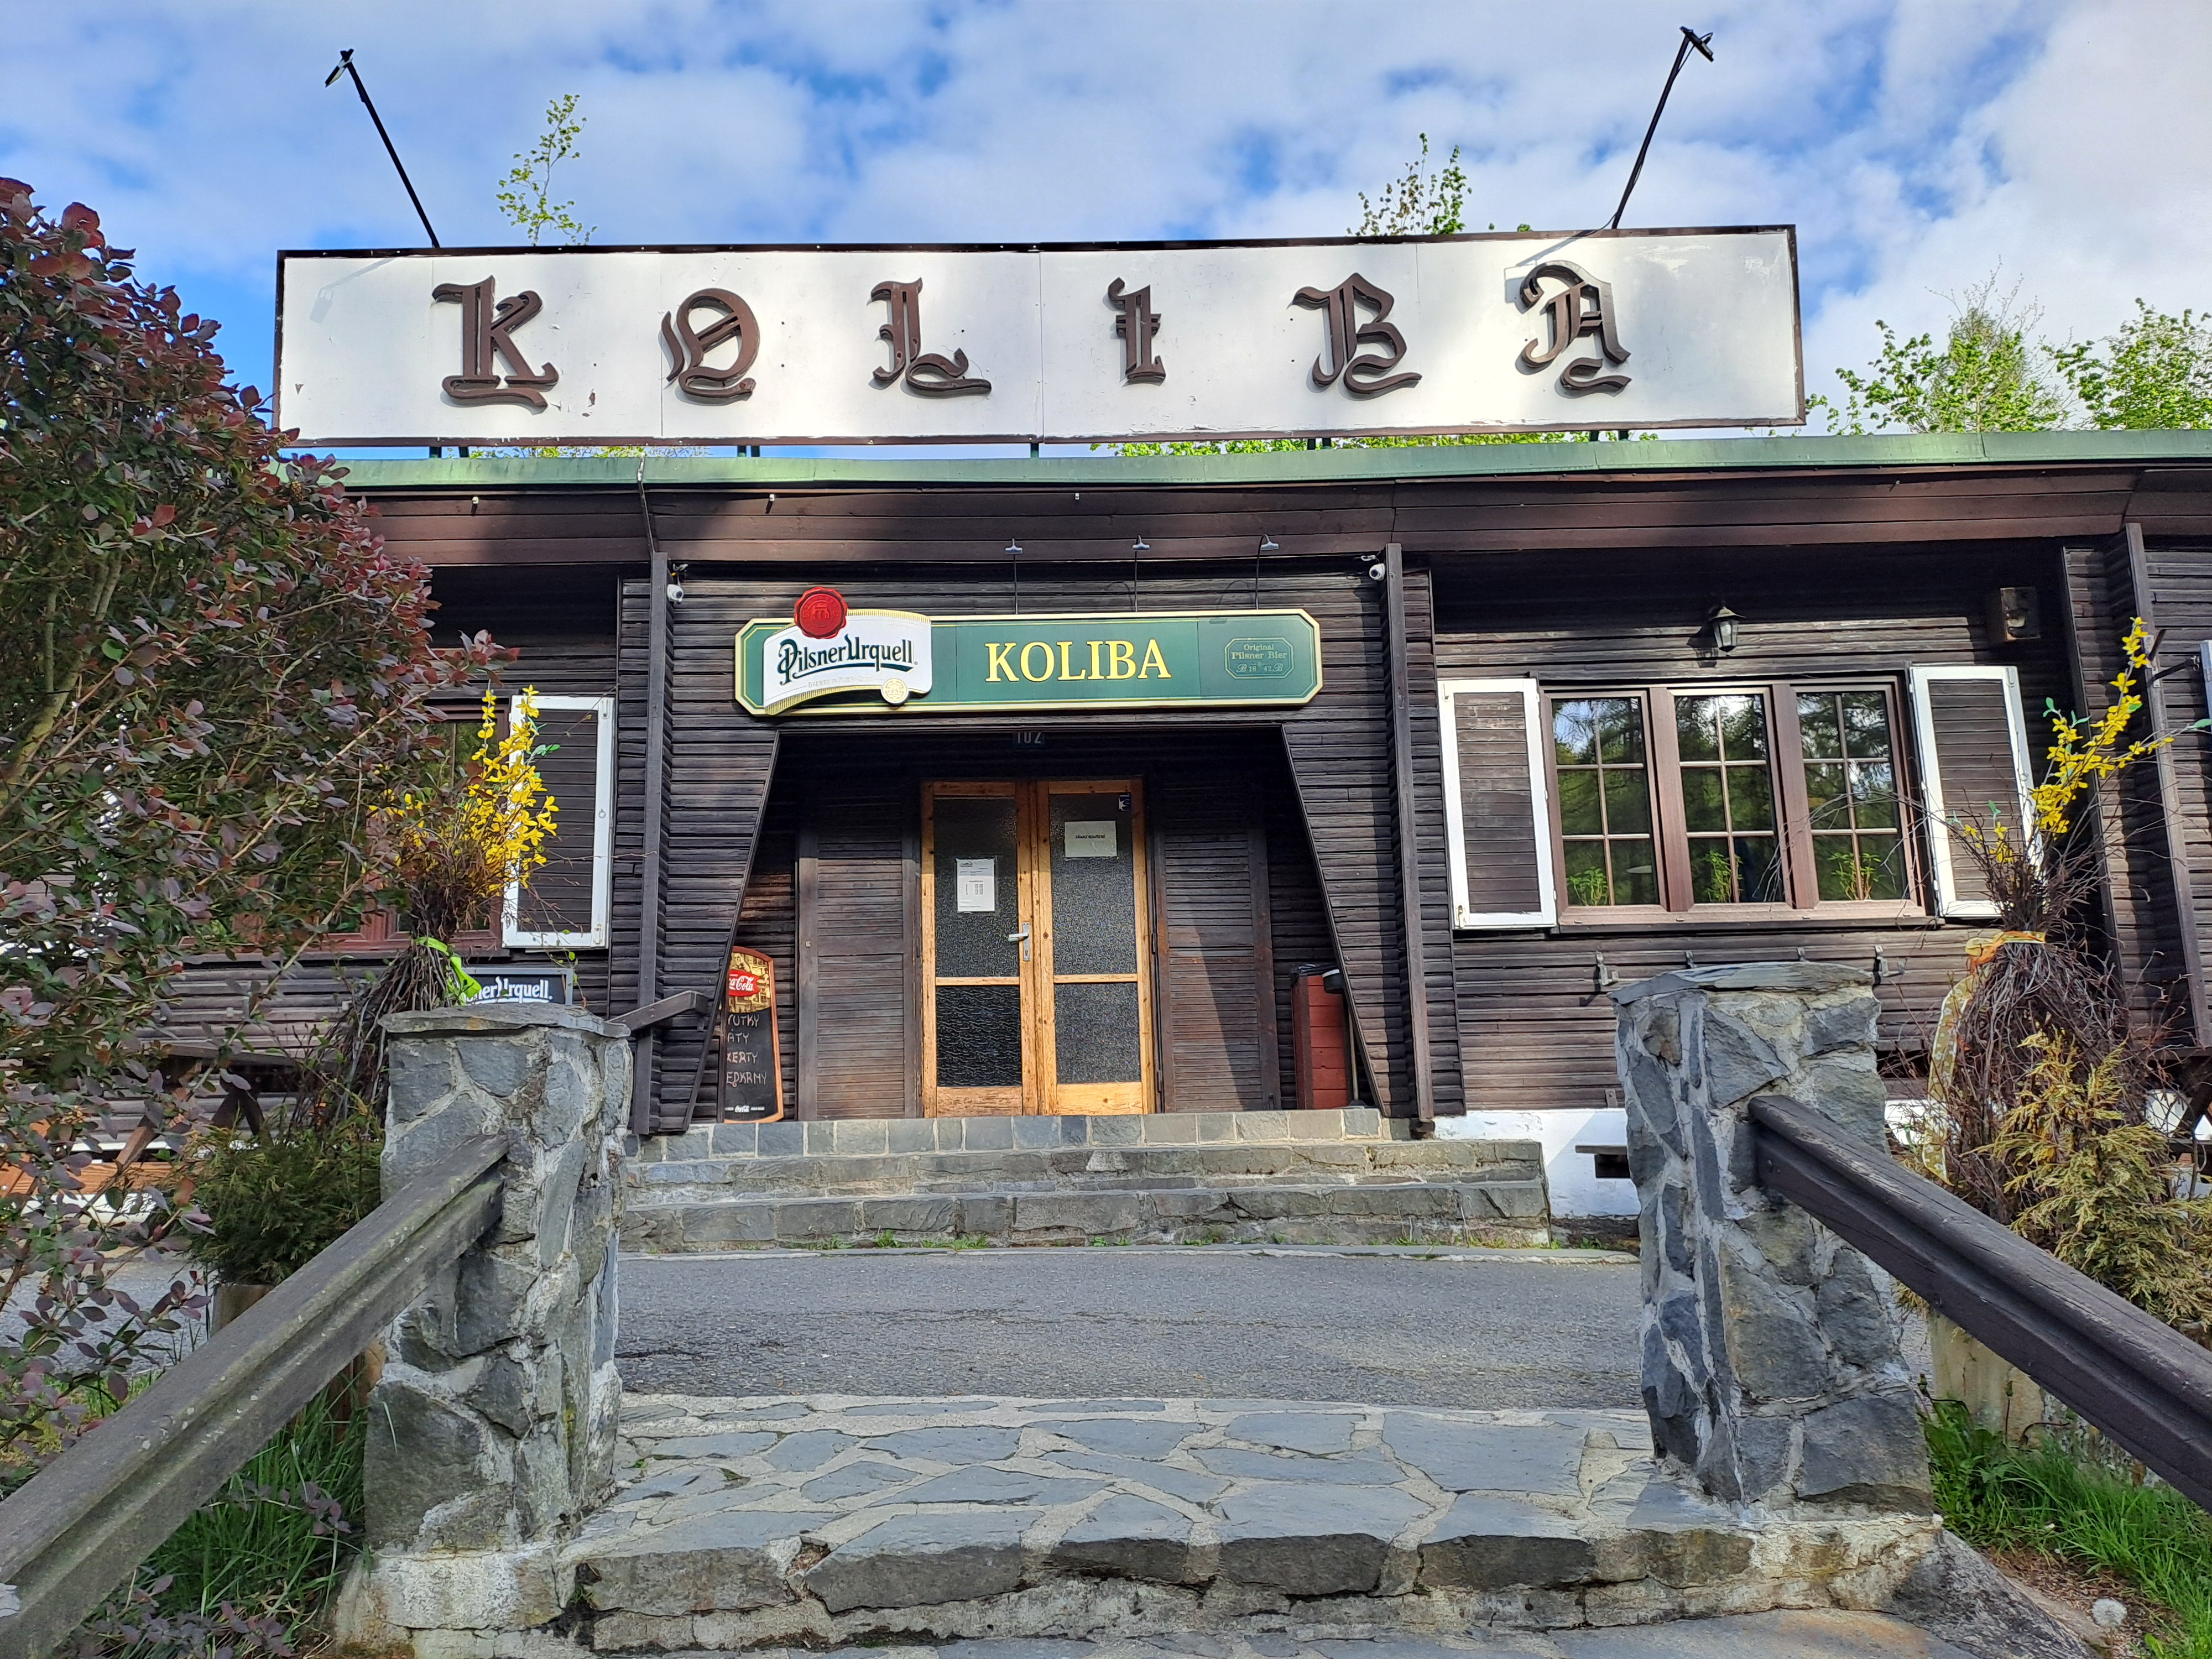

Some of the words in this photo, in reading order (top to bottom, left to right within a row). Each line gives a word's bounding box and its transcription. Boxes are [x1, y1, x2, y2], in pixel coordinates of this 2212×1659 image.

[777, 638, 846, 686] Pilsner
[844, 634, 914, 672] Urquell
[985, 639, 1172, 682] KOLIBA
[1231, 651, 1264, 660] Pilsner
[1267, 651, 1287, 659] Bier
[495, 976, 549, 1004] Urquell
[728, 1014, 760, 1027] UTKY
[727, 1029, 749, 1044] ÁTY
[727, 1051, 758, 1065] ZERTY
[726, 1071, 767, 1088] EDKRMY
